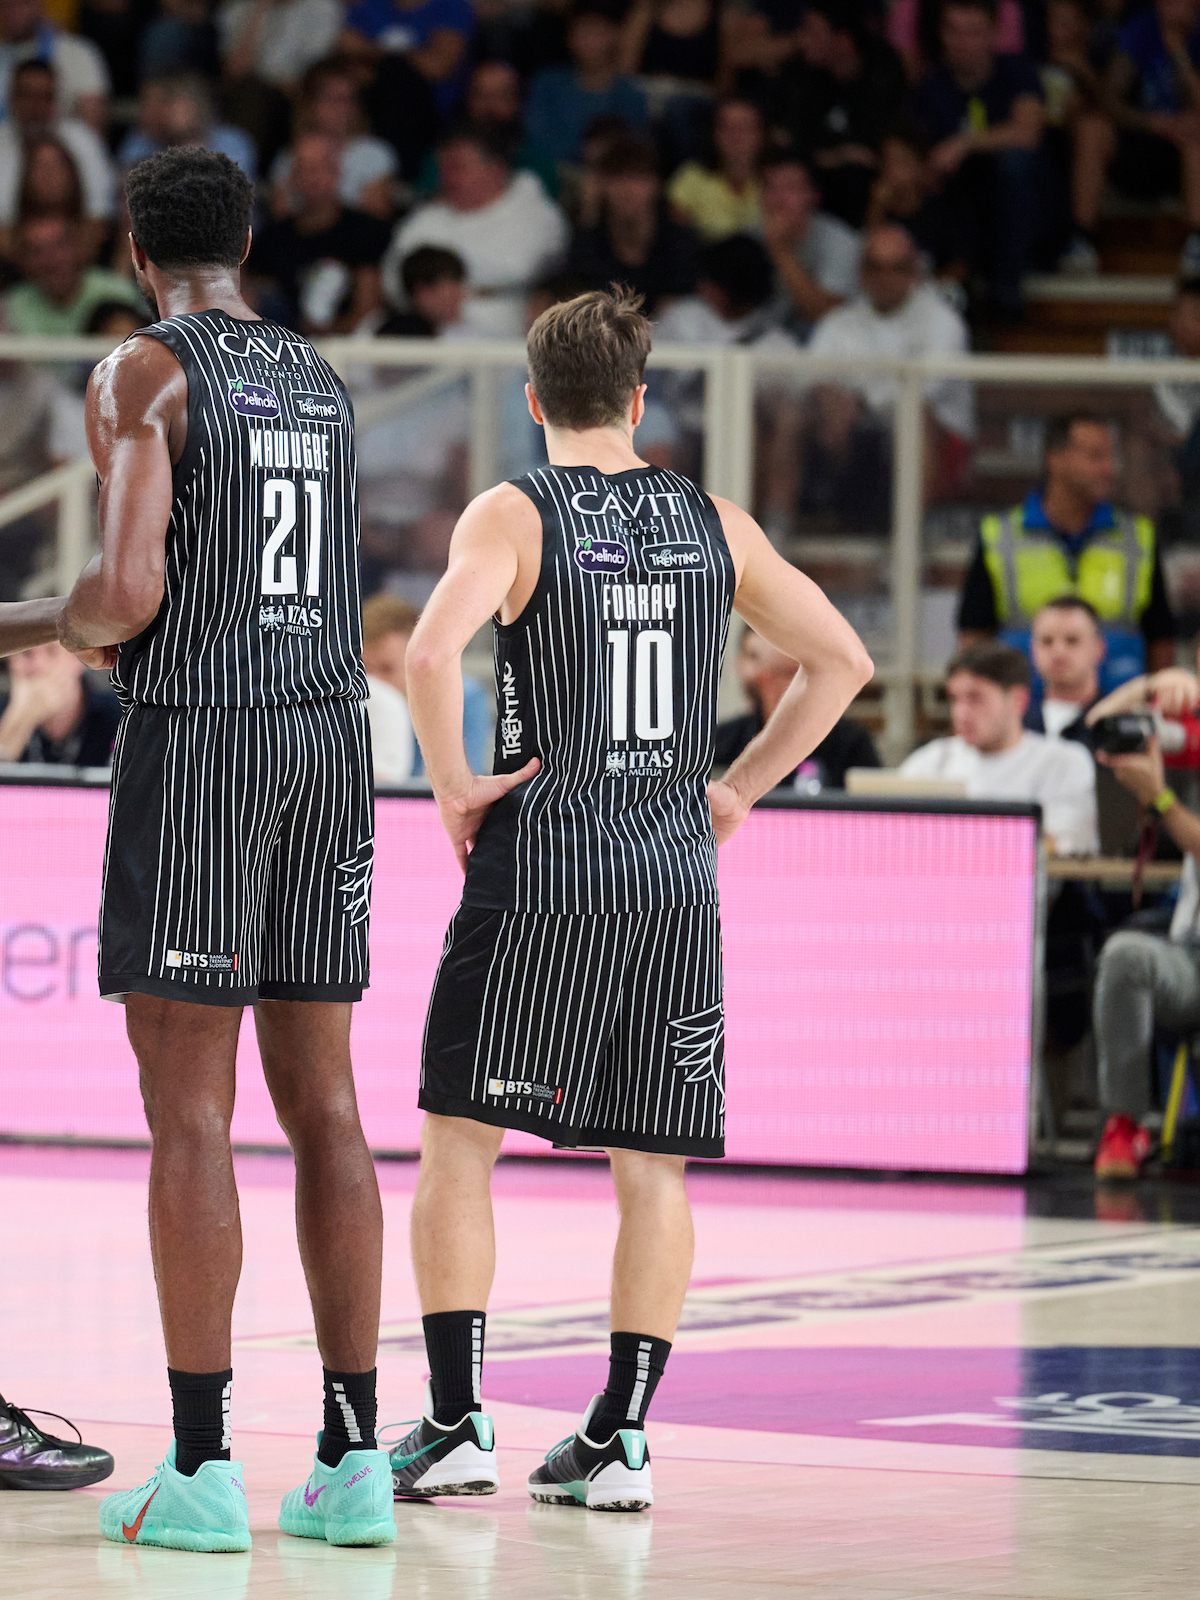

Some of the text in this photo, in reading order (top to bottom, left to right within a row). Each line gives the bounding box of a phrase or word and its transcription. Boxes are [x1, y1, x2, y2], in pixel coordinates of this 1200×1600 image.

[218, 331, 313, 367] CAVIT
[256, 368, 302, 381] TRENTO
[232, 391, 277, 409] Melinda
[296, 400, 337, 417] TRENTINO
[250, 428, 329, 472] MAWUGBE
[571, 491, 681, 521] CAVIT
[261, 477, 323, 597] 21
[611, 524, 659, 536] TRENTO
[579, 547, 625, 564] Melinda
[649, 551, 701, 567] TRENTINO
[603, 583, 676, 621] FORRAY
[286, 605, 323, 628] ITAS
[285, 625, 312, 636] MUTUA
[607, 629, 675, 741] 10
[628, 749, 674, 768] ITAS
[628, 768, 663, 777] MUTUA
[183, 952, 208, 968] BTS
[505, 1080, 532, 1095] BTS
[343, 1465, 373, 1490] TWELVE
